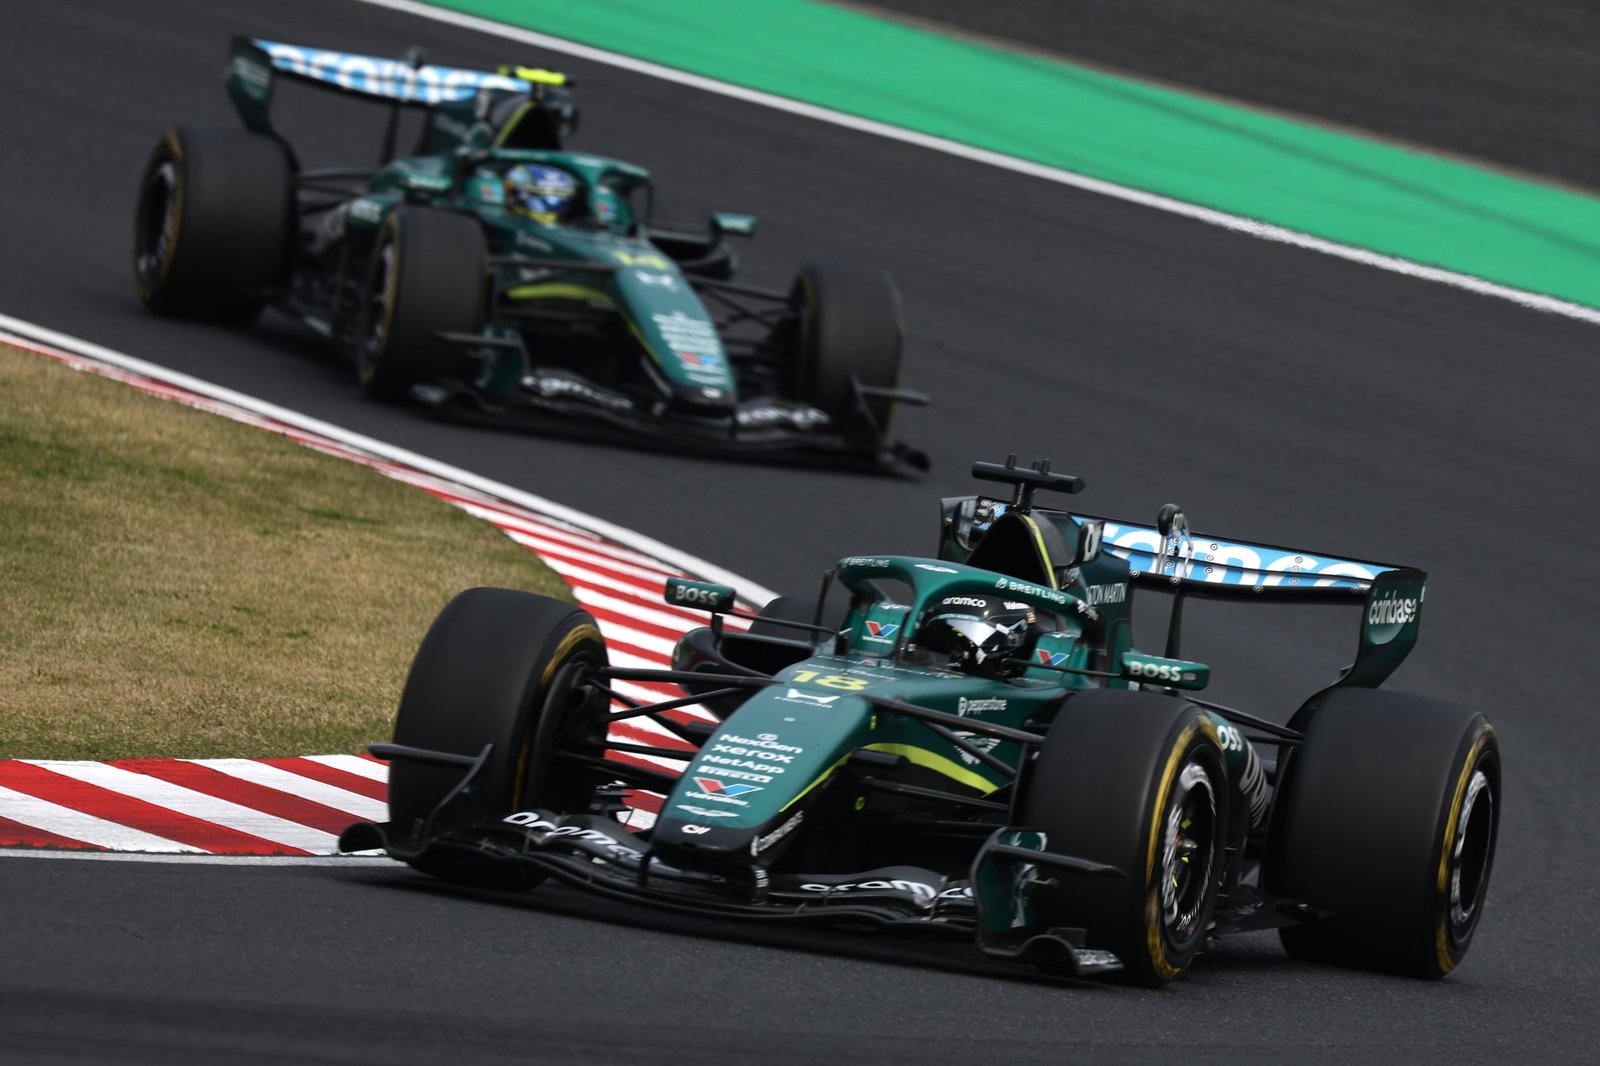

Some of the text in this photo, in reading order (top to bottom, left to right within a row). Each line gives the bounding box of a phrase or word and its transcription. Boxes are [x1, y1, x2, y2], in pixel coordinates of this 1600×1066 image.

[849, 557, 891, 568] BREITLING
[675, 585, 718, 605] BOSS
[942, 597, 987, 608] aramco
[1009, 581, 1066, 605] BREITLING
[1104, 582, 1128, 604] MARTIN
[1369, 590, 1417, 625] coinbase
[792, 670, 869, 691] 18
[1129, 661, 1182, 682] BOSS
[719, 734, 804, 754] NexGen
[1217, 725, 1243, 752] OSS
[701, 754, 785, 774] NetApp
[710, 744, 795, 764] xerox
